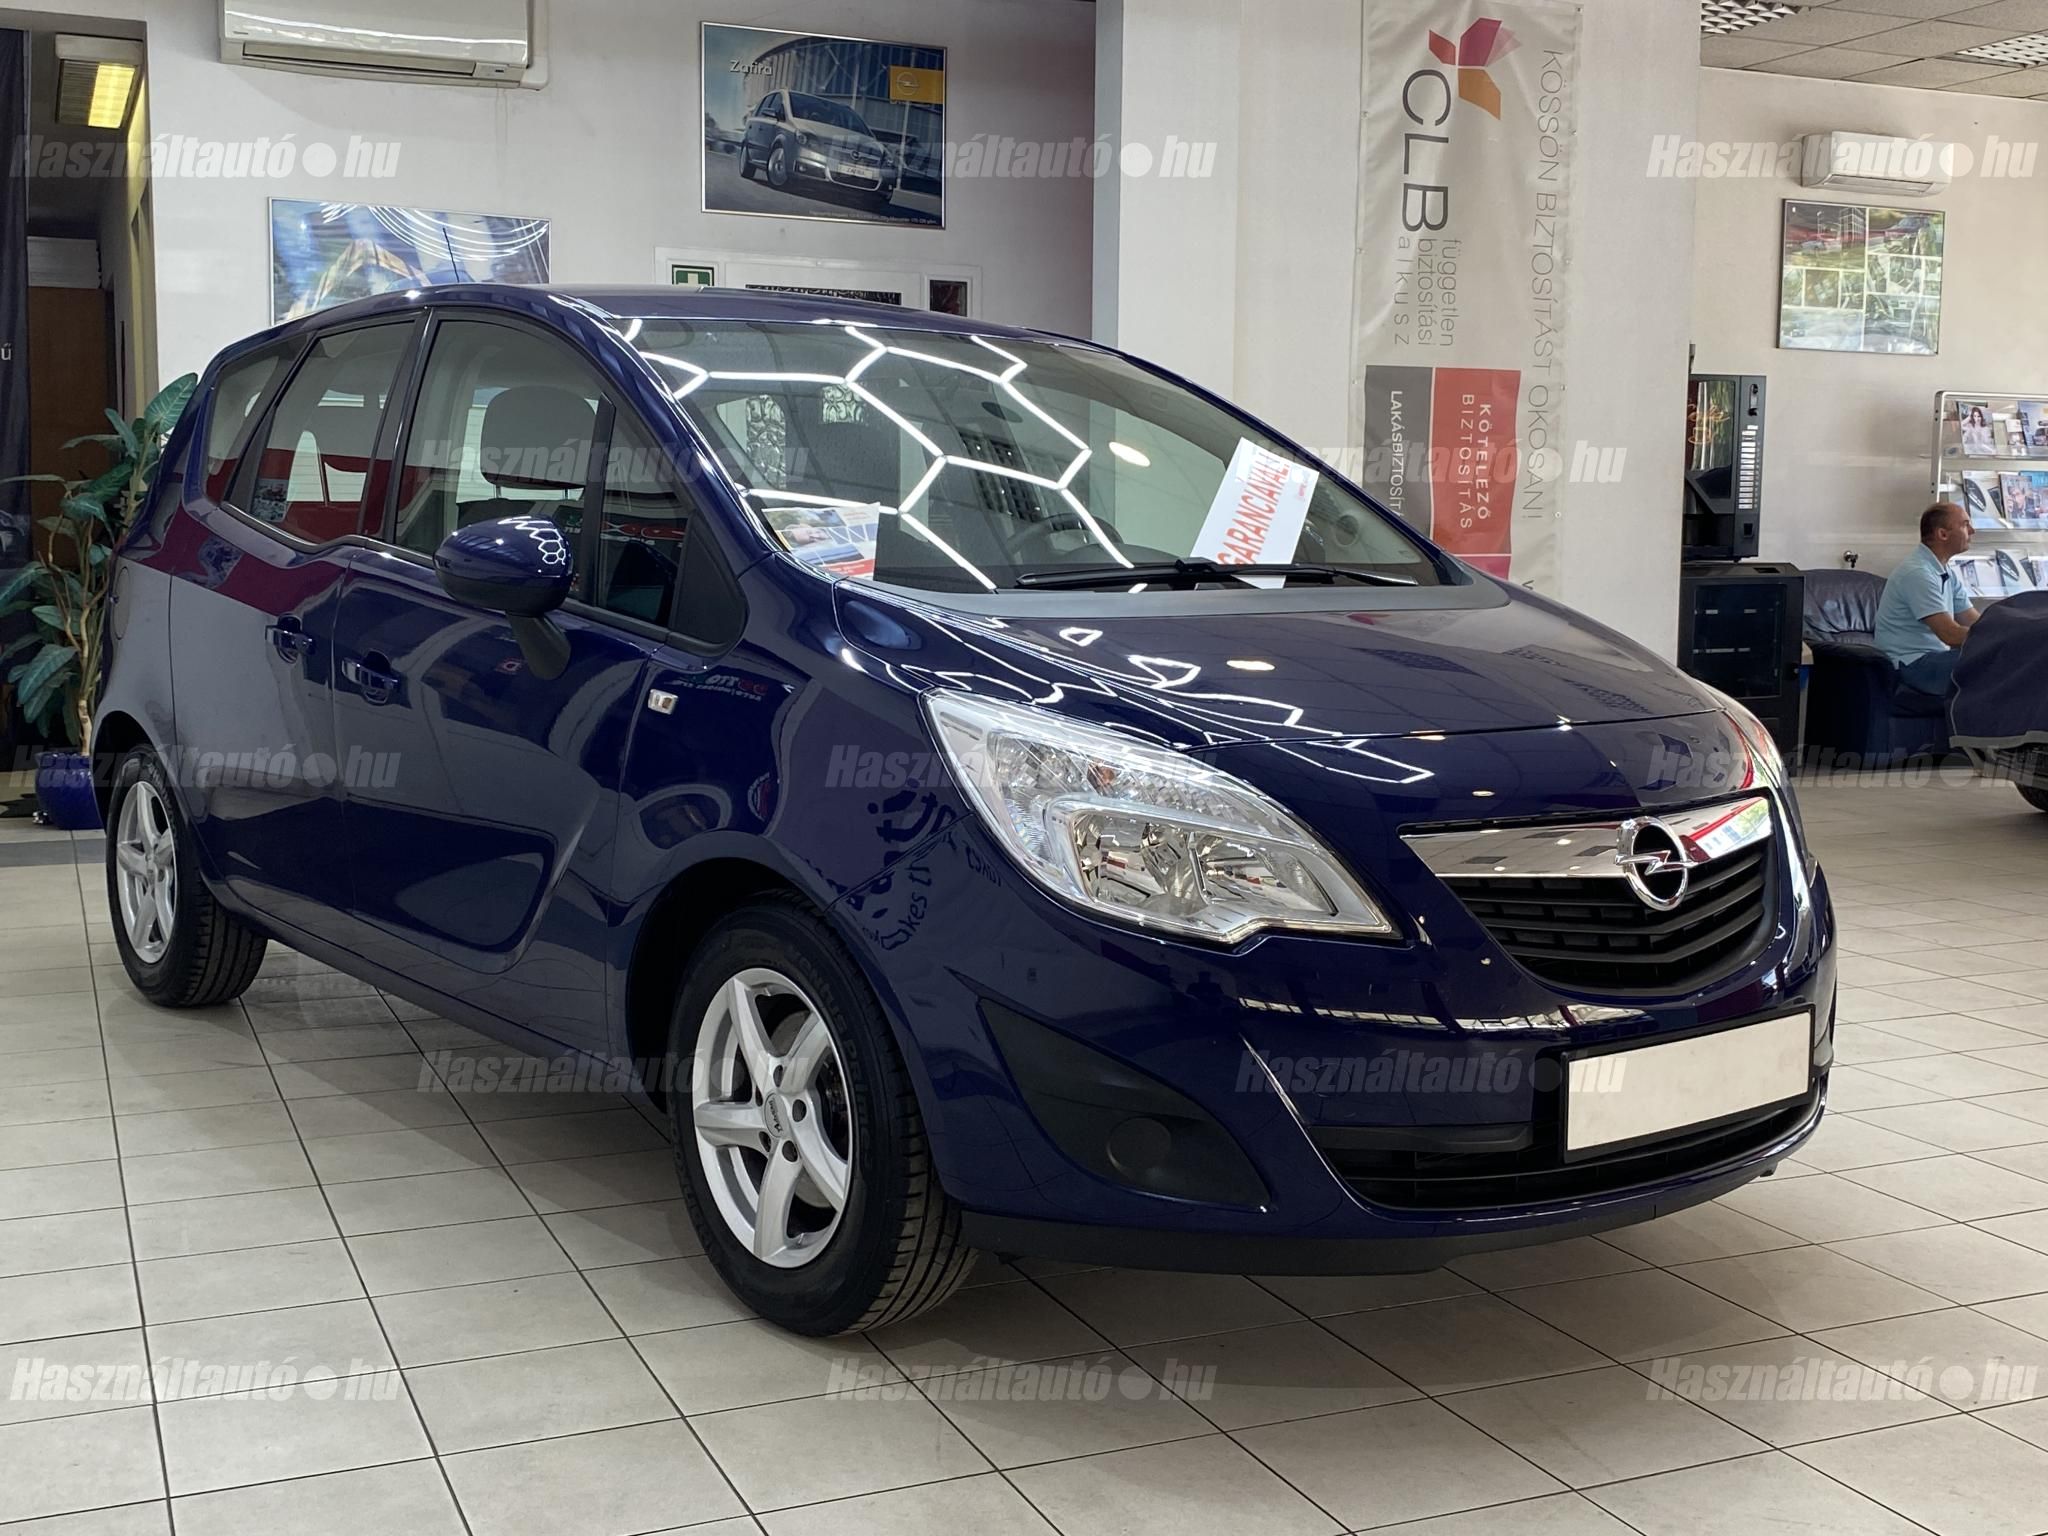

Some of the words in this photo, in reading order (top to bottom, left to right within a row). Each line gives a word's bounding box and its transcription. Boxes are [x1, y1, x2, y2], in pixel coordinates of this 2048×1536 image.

[729, 60, 774, 77] Zafira
[1537, 50, 1568, 182] KÖSSÖN
[1402, 69, 1452, 232] CLB
[1417, 238, 1438, 346] biztosítási
[1436, 238, 1462, 347] független
[1530, 192, 1558, 376] BIZTOSÍTÁST
[1458, 394, 1474, 529] BIZTOSÍTÁS
[1476, 404, 1492, 519] KÖTELEZŐ
[1523, 385, 1550, 519] OKOSAN!
